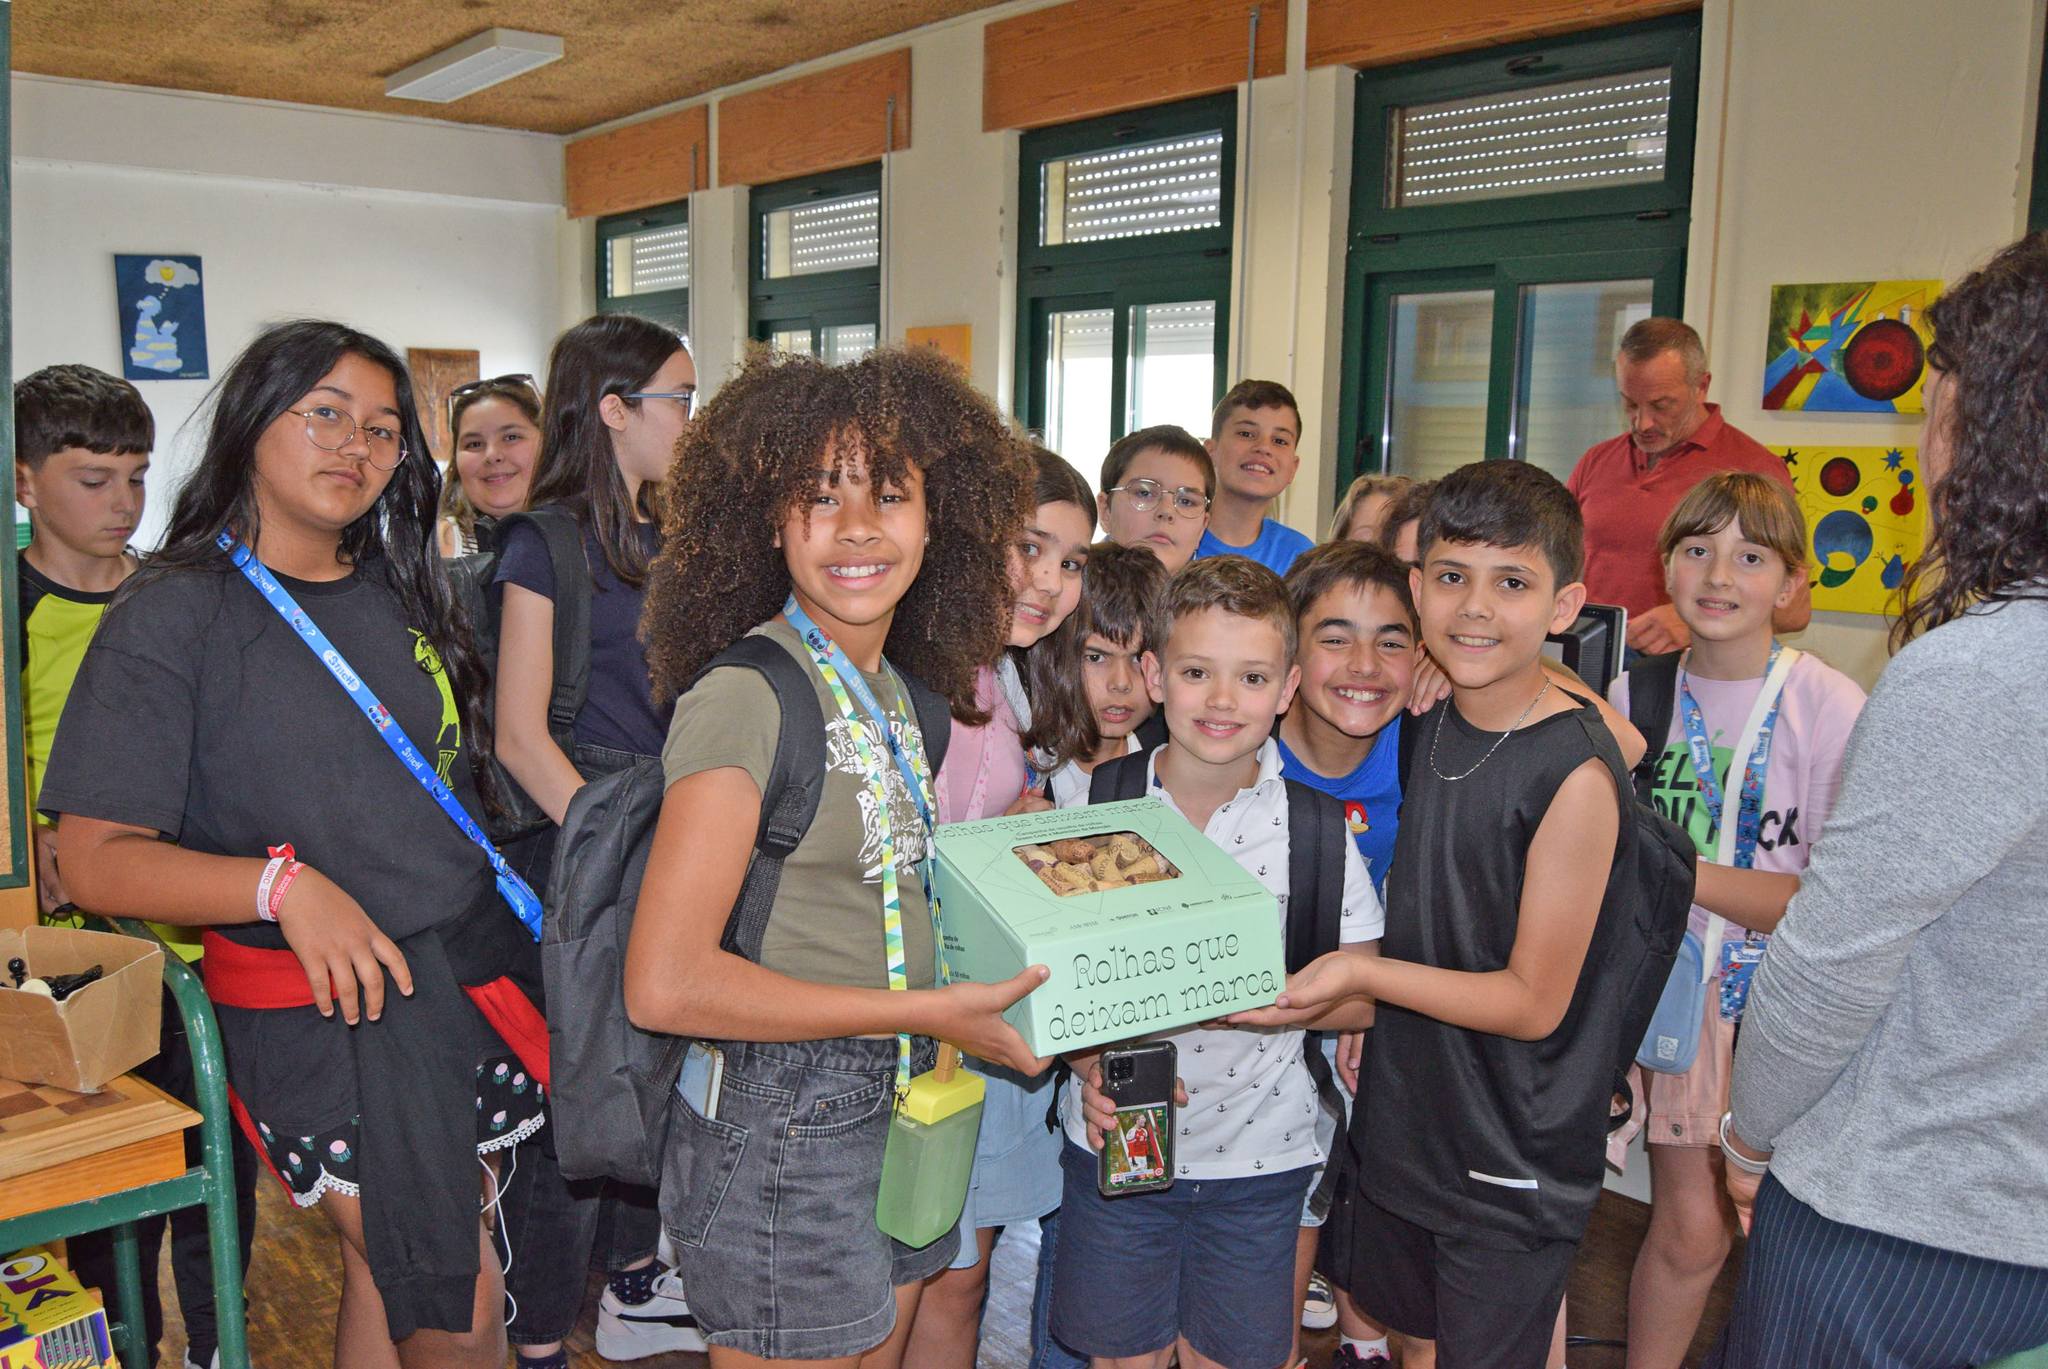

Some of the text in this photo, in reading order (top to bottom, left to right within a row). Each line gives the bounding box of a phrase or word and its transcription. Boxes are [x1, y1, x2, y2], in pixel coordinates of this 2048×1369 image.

[1073, 932, 1240, 990] Rolhas que
[1049, 969, 1279, 1041] deixam marca
